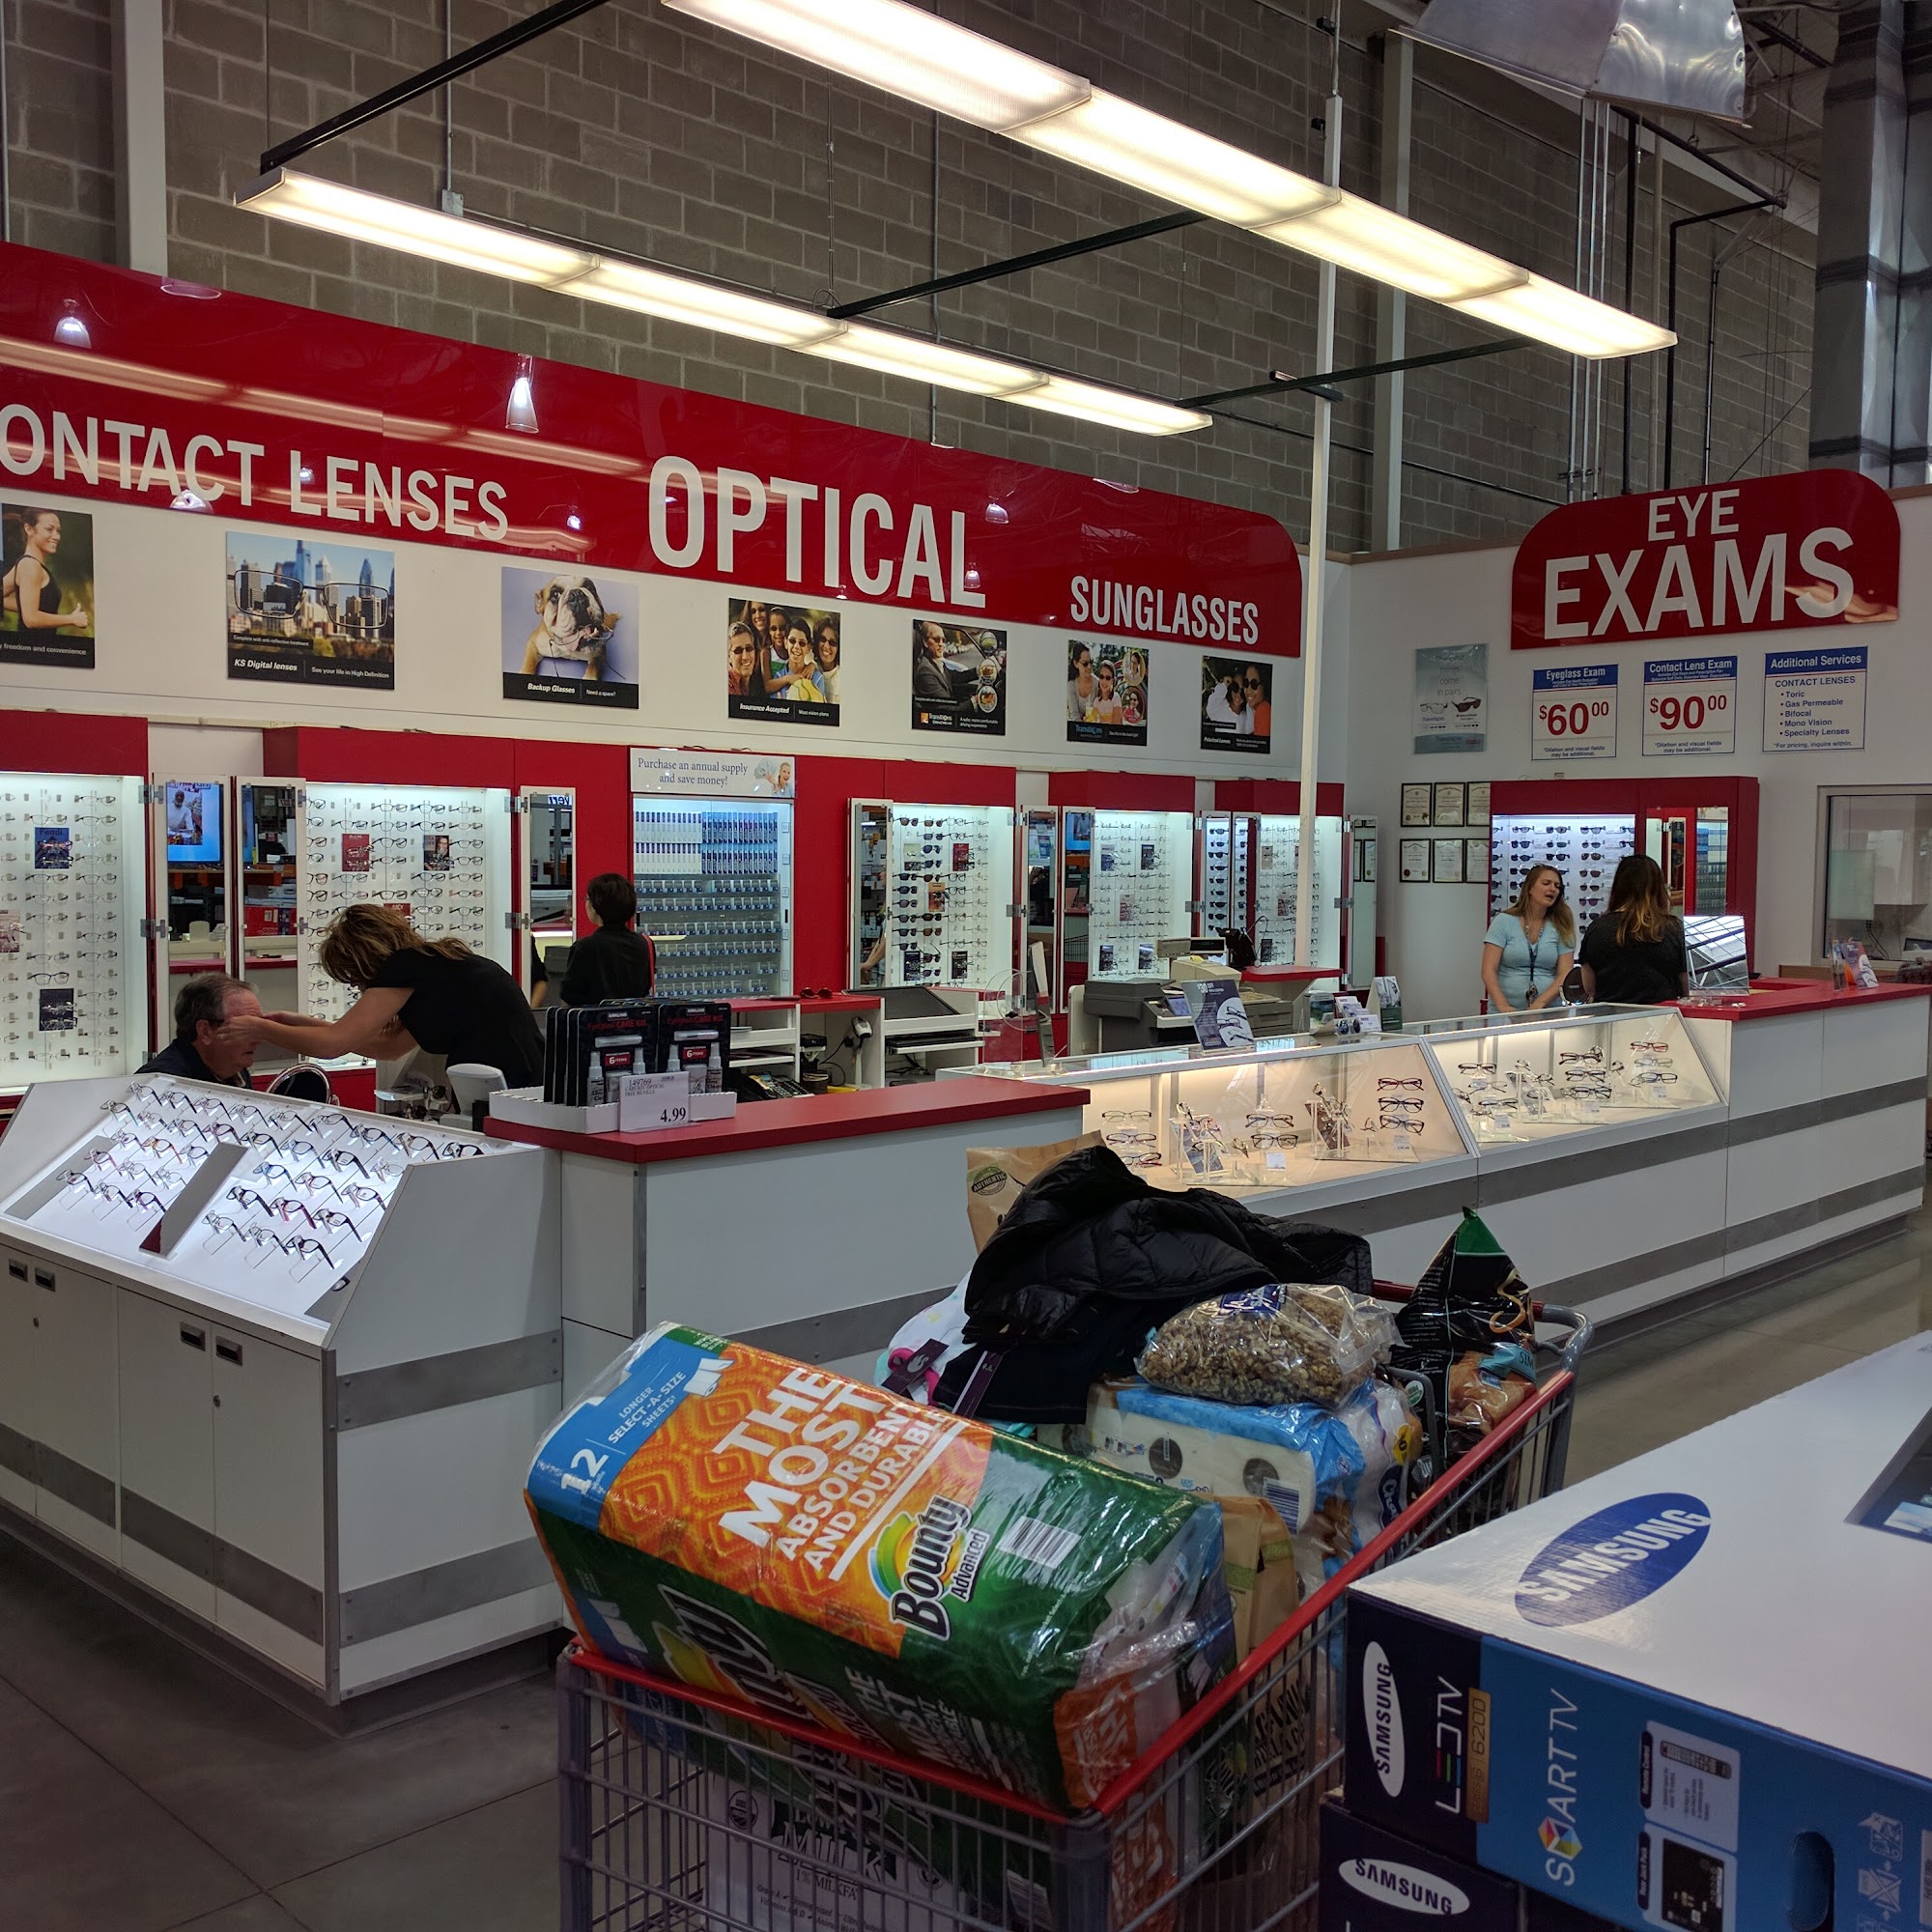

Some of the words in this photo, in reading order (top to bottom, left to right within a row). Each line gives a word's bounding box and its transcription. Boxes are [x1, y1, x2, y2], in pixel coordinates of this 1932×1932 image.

[291, 449, 508, 541] LENSES
[1648, 489, 1740, 542] EYE
[648, 455, 986, 609] OPTICAL
[1546, 526, 1854, 639] EXAMS
[1070, 575, 1260, 645] SUNGLASSES
[46, 647, 87, 656] convenience
[234, 658, 246, 668] KS
[247, 660, 272, 671] Digital
[273, 661, 298, 671] lenses
[1770, 655, 1818, 669] Additional
[1820, 654, 1862, 667] Services
[311, 666, 323, 674] See
[351, 669, 364, 678] High
[1546, 668, 1581, 682] Eyeglass
[1583, 668, 1605, 677] Exam
[1649, 662, 1683, 673] Contact
[1684, 661, 1706, 671] Lens
[1707, 659, 1732, 669] Exam
[526, 682, 552, 694] Backup
[552, 684, 576, 695] Glasses
[1775, 677, 1818, 688] CONTACT
[1819, 675, 1856, 685] LENSES
[739, 702, 765, 712] Insurance
[765, 706, 790, 715] Accepted
[1784, 709, 1812, 718] Bifocal
[1802, 698, 1844, 707] Permeable
[1783, 729, 1820, 738] Specialty
[638, 757, 677, 770] Purchase
[691, 761, 720, 772] annual
[721, 762, 749, 776] supply
[659, 774, 675, 783] and
[677, 776, 696, 784] save
[696, 776, 728, 788] money!
[615, 1019, 635, 1029] CARE
[609, 1056, 615, 1065] 6
[629, 1077, 652, 1088] 149769
[660, 1106, 687, 1122] 4.99
[973, 1172, 1007, 1192] AUTHENTIC
[618, 1385, 654, 1419] LONGER
[711, 1366, 837, 1457] THE
[560, 1448, 610, 1496] 12
[718, 1380, 887, 1548] MOST
[775, 1403, 916, 1561] ABSORBENT
[804, 1510, 858, 1572] AND
[892, 1494, 973, 1639] Bounty
[951, 1529, 989, 1601] Advanced
[1520, 1507, 1713, 1604] SAMSUNG
[843, 1664, 891, 1717] THE
[1376, 1662, 1392, 1775] SAMSUNG
[1548, 1688, 1579, 1731] TV
[779, 1820, 886, 1884] MILK
[1354, 1859, 1453, 1915] SAMSUNG
